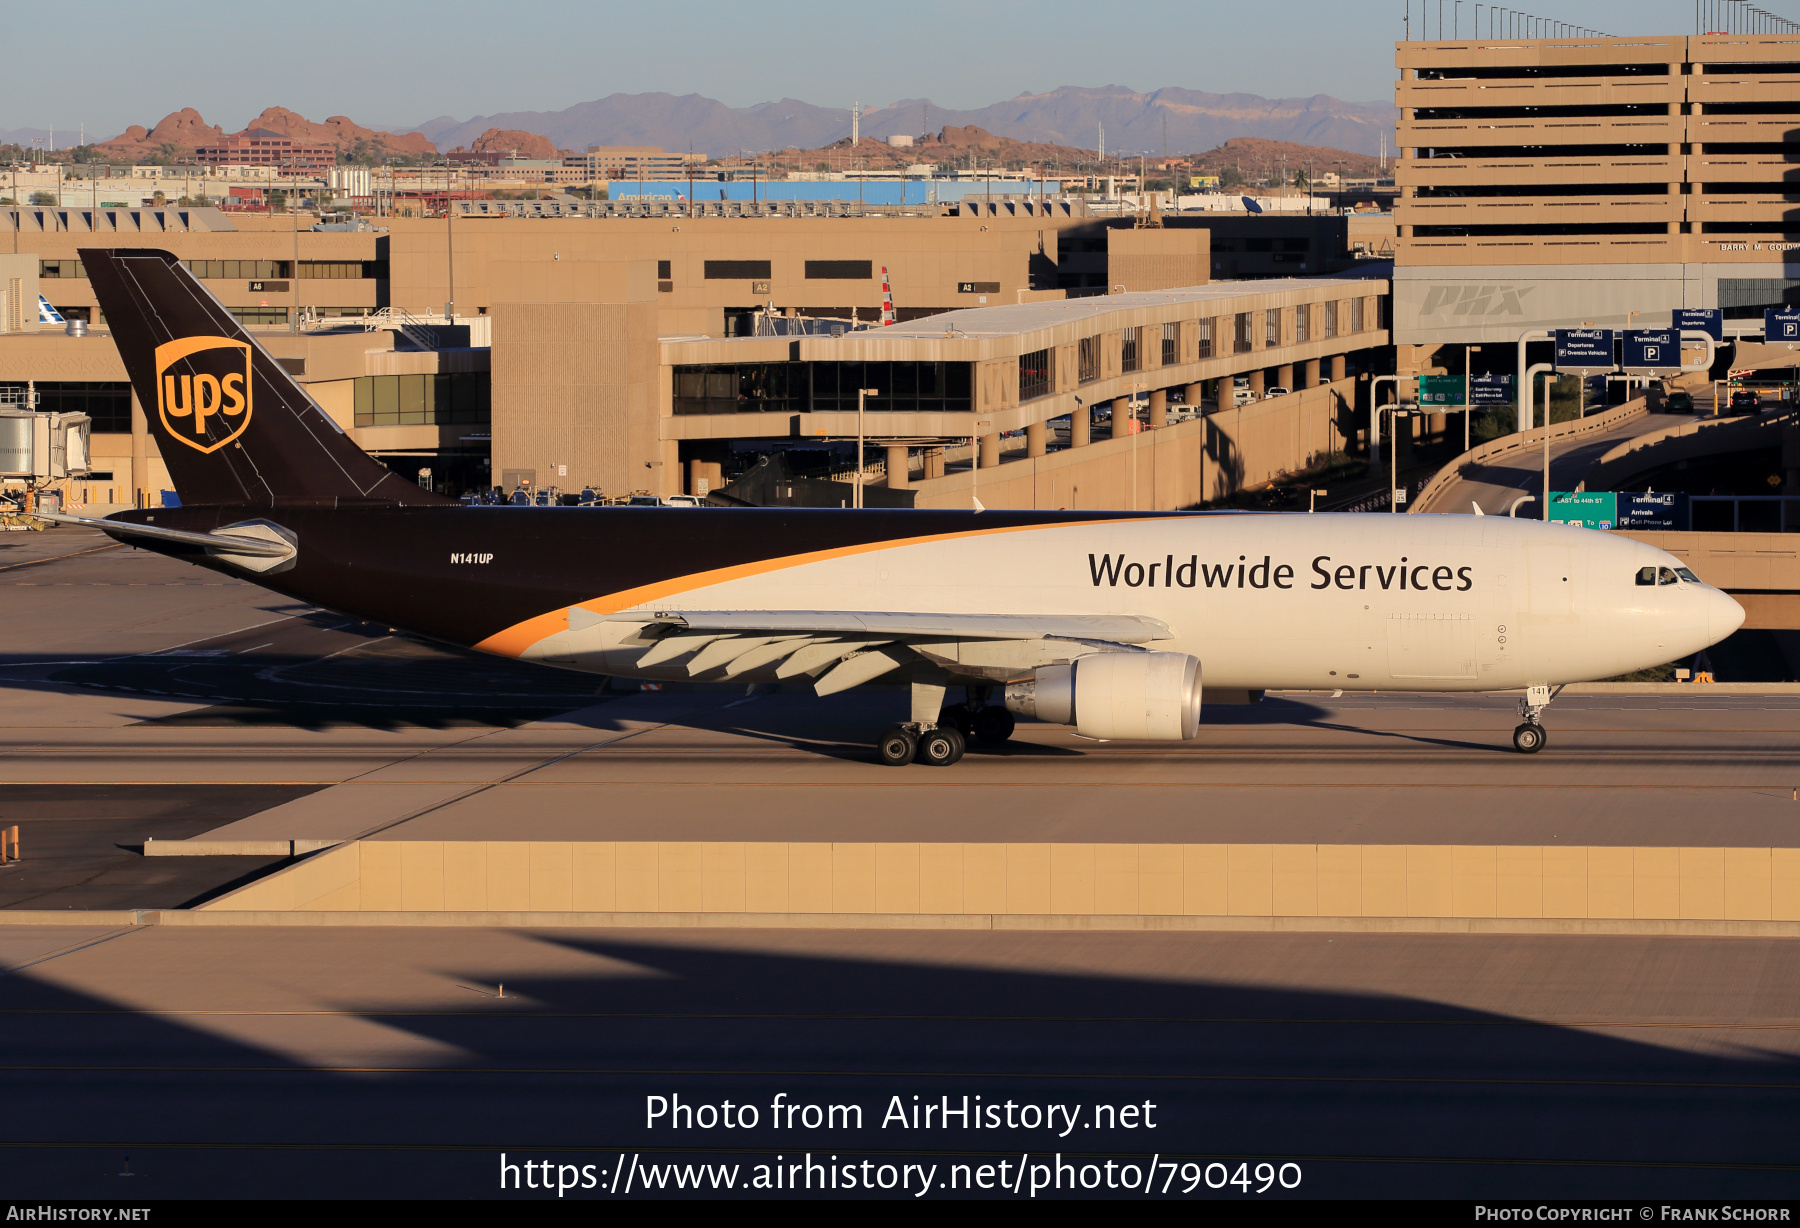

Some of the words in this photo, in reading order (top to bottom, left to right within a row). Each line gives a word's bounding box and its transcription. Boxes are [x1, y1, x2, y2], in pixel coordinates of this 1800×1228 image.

[618, 192, 672, 200] American
[1419, 286, 1537, 315] PHX
[1786, 325, 1795, 335] P
[1647, 348, 1656, 358] P
[165, 372, 246, 434] ups
[451, 553, 493, 564] N141UP
[1088, 553, 1294, 589] Worldwide
[1310, 556, 1473, 592] Services
[1532, 686, 1545, 695] 141
